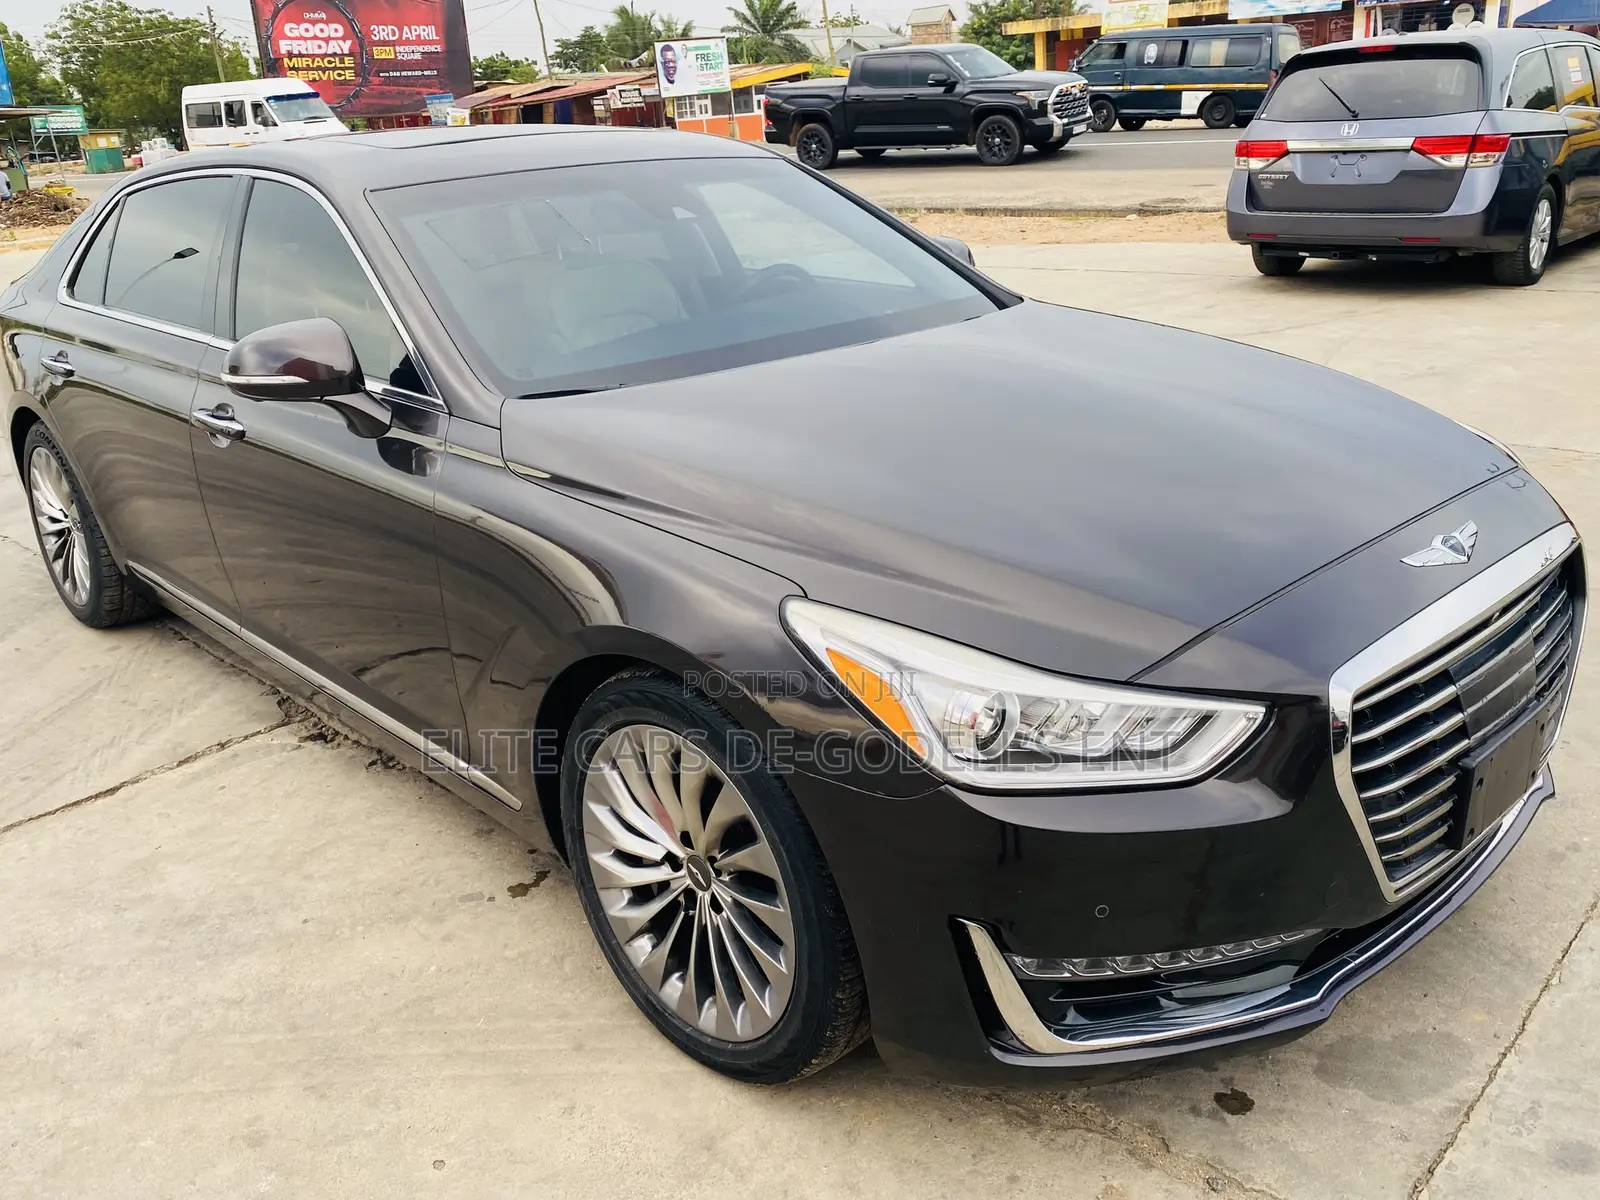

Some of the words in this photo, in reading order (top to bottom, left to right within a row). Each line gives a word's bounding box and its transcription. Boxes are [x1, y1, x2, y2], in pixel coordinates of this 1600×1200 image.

[284, 23, 344, 38] GOOD
[370, 25, 399, 41] 3RD
[402, 25, 440, 40] APRIL
[279, 39, 352, 55] FRIDAY
[395, 45, 442, 53] INDEPENDENCE
[374, 48, 393, 57] 3PM
[695, 52, 724, 62] FRESH
[283, 57, 355, 68] MIRACLE
[699, 62, 724, 71] START
[286, 70, 356, 80] SERVICE
